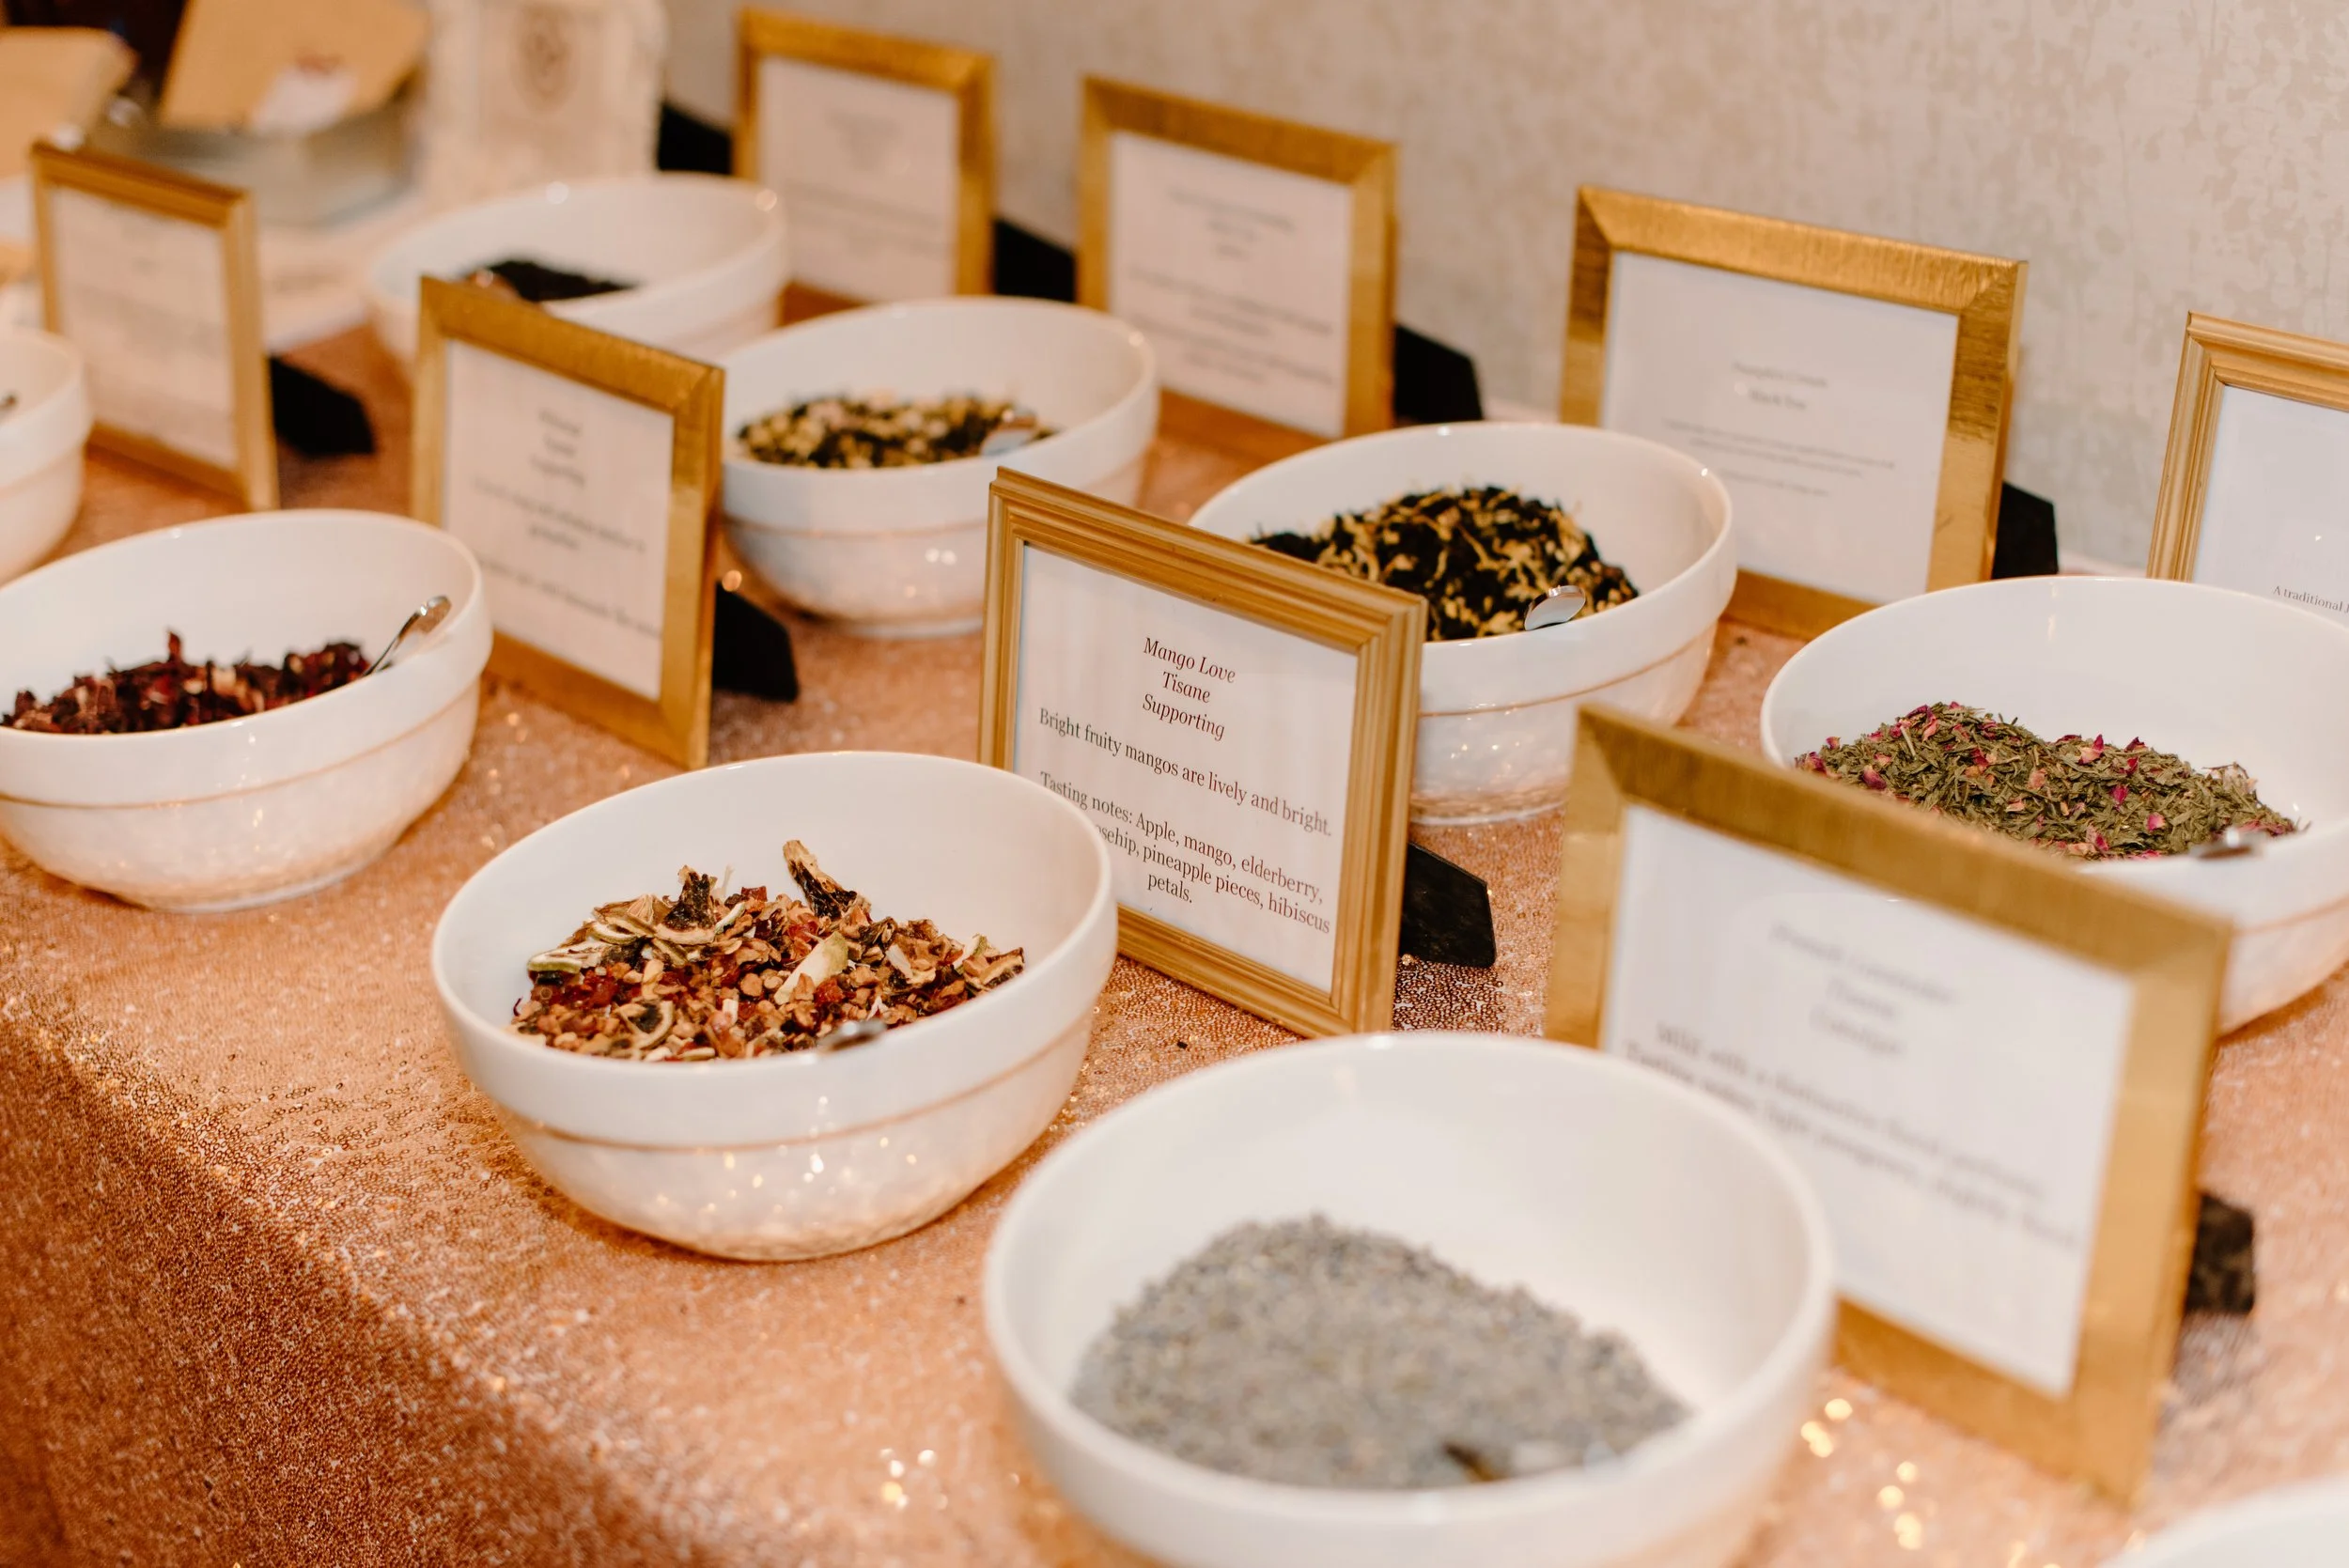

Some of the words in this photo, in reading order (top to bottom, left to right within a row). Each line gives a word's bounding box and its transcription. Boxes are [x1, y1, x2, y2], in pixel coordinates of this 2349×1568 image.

[2273, 585, 2281, 597] A
[2283, 588, 2343, 612] traditional
[1143, 637, 1195, 669] Mango
[1198, 657, 1236, 683] Love
[1163, 671, 1210, 703] Tisane
[1143, 693, 1224, 741] Supporting
[1040, 707, 1081, 738] Bright
[1085, 724, 1122, 756] fruity
[1126, 744, 1178, 776] mangos
[1182, 768, 1205, 786] are
[1208, 771, 1247, 805] lively
[1251, 794, 1278, 815] and
[1283, 800, 1330, 836] bright.
[1040, 771, 1088, 811] Tasting
[1092, 798, 1132, 824] notes:
[1136, 813, 1179, 847] Apple,
[1184, 835, 1236, 870] mango,
[1241, 859, 1322, 905] elderberry,
[1097, 825, 1139, 857] sehip,
[1143, 846, 1211, 885] pineapple
[1215, 876, 1263, 909] pieces,
[1268, 892, 1330, 933] hibiscus
[1147, 874, 1191, 904] petals.
